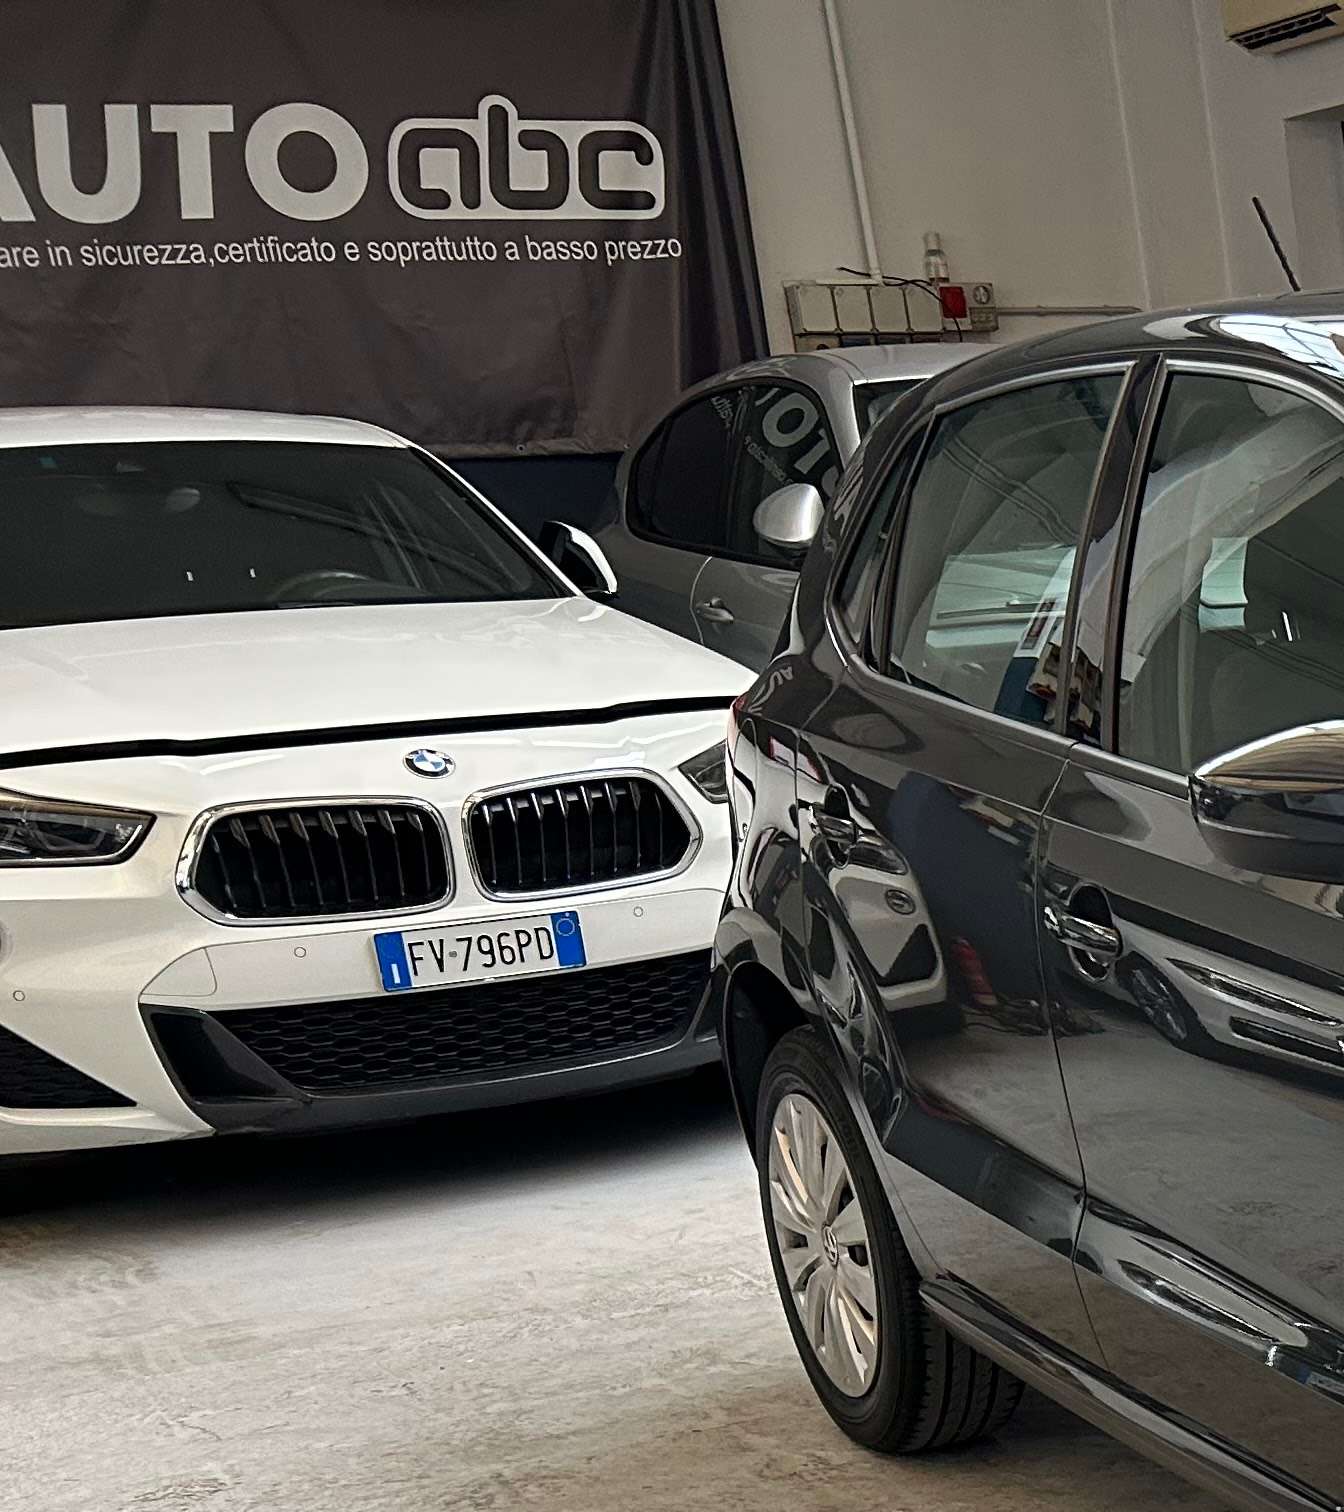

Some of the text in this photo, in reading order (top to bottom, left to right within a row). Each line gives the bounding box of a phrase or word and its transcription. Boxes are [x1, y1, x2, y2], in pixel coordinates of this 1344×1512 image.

[393, 98, 661, 216] abc
[46, 240, 72, 266] in
[81, 236, 336, 267] sicurezza,certificato
[344, 241, 360, 261] e
[369, 236, 497, 267] soprattutto
[504, 240, 520, 260] a
[525, 235, 598, 261] basso
[605, 238, 682, 267] prezzo
